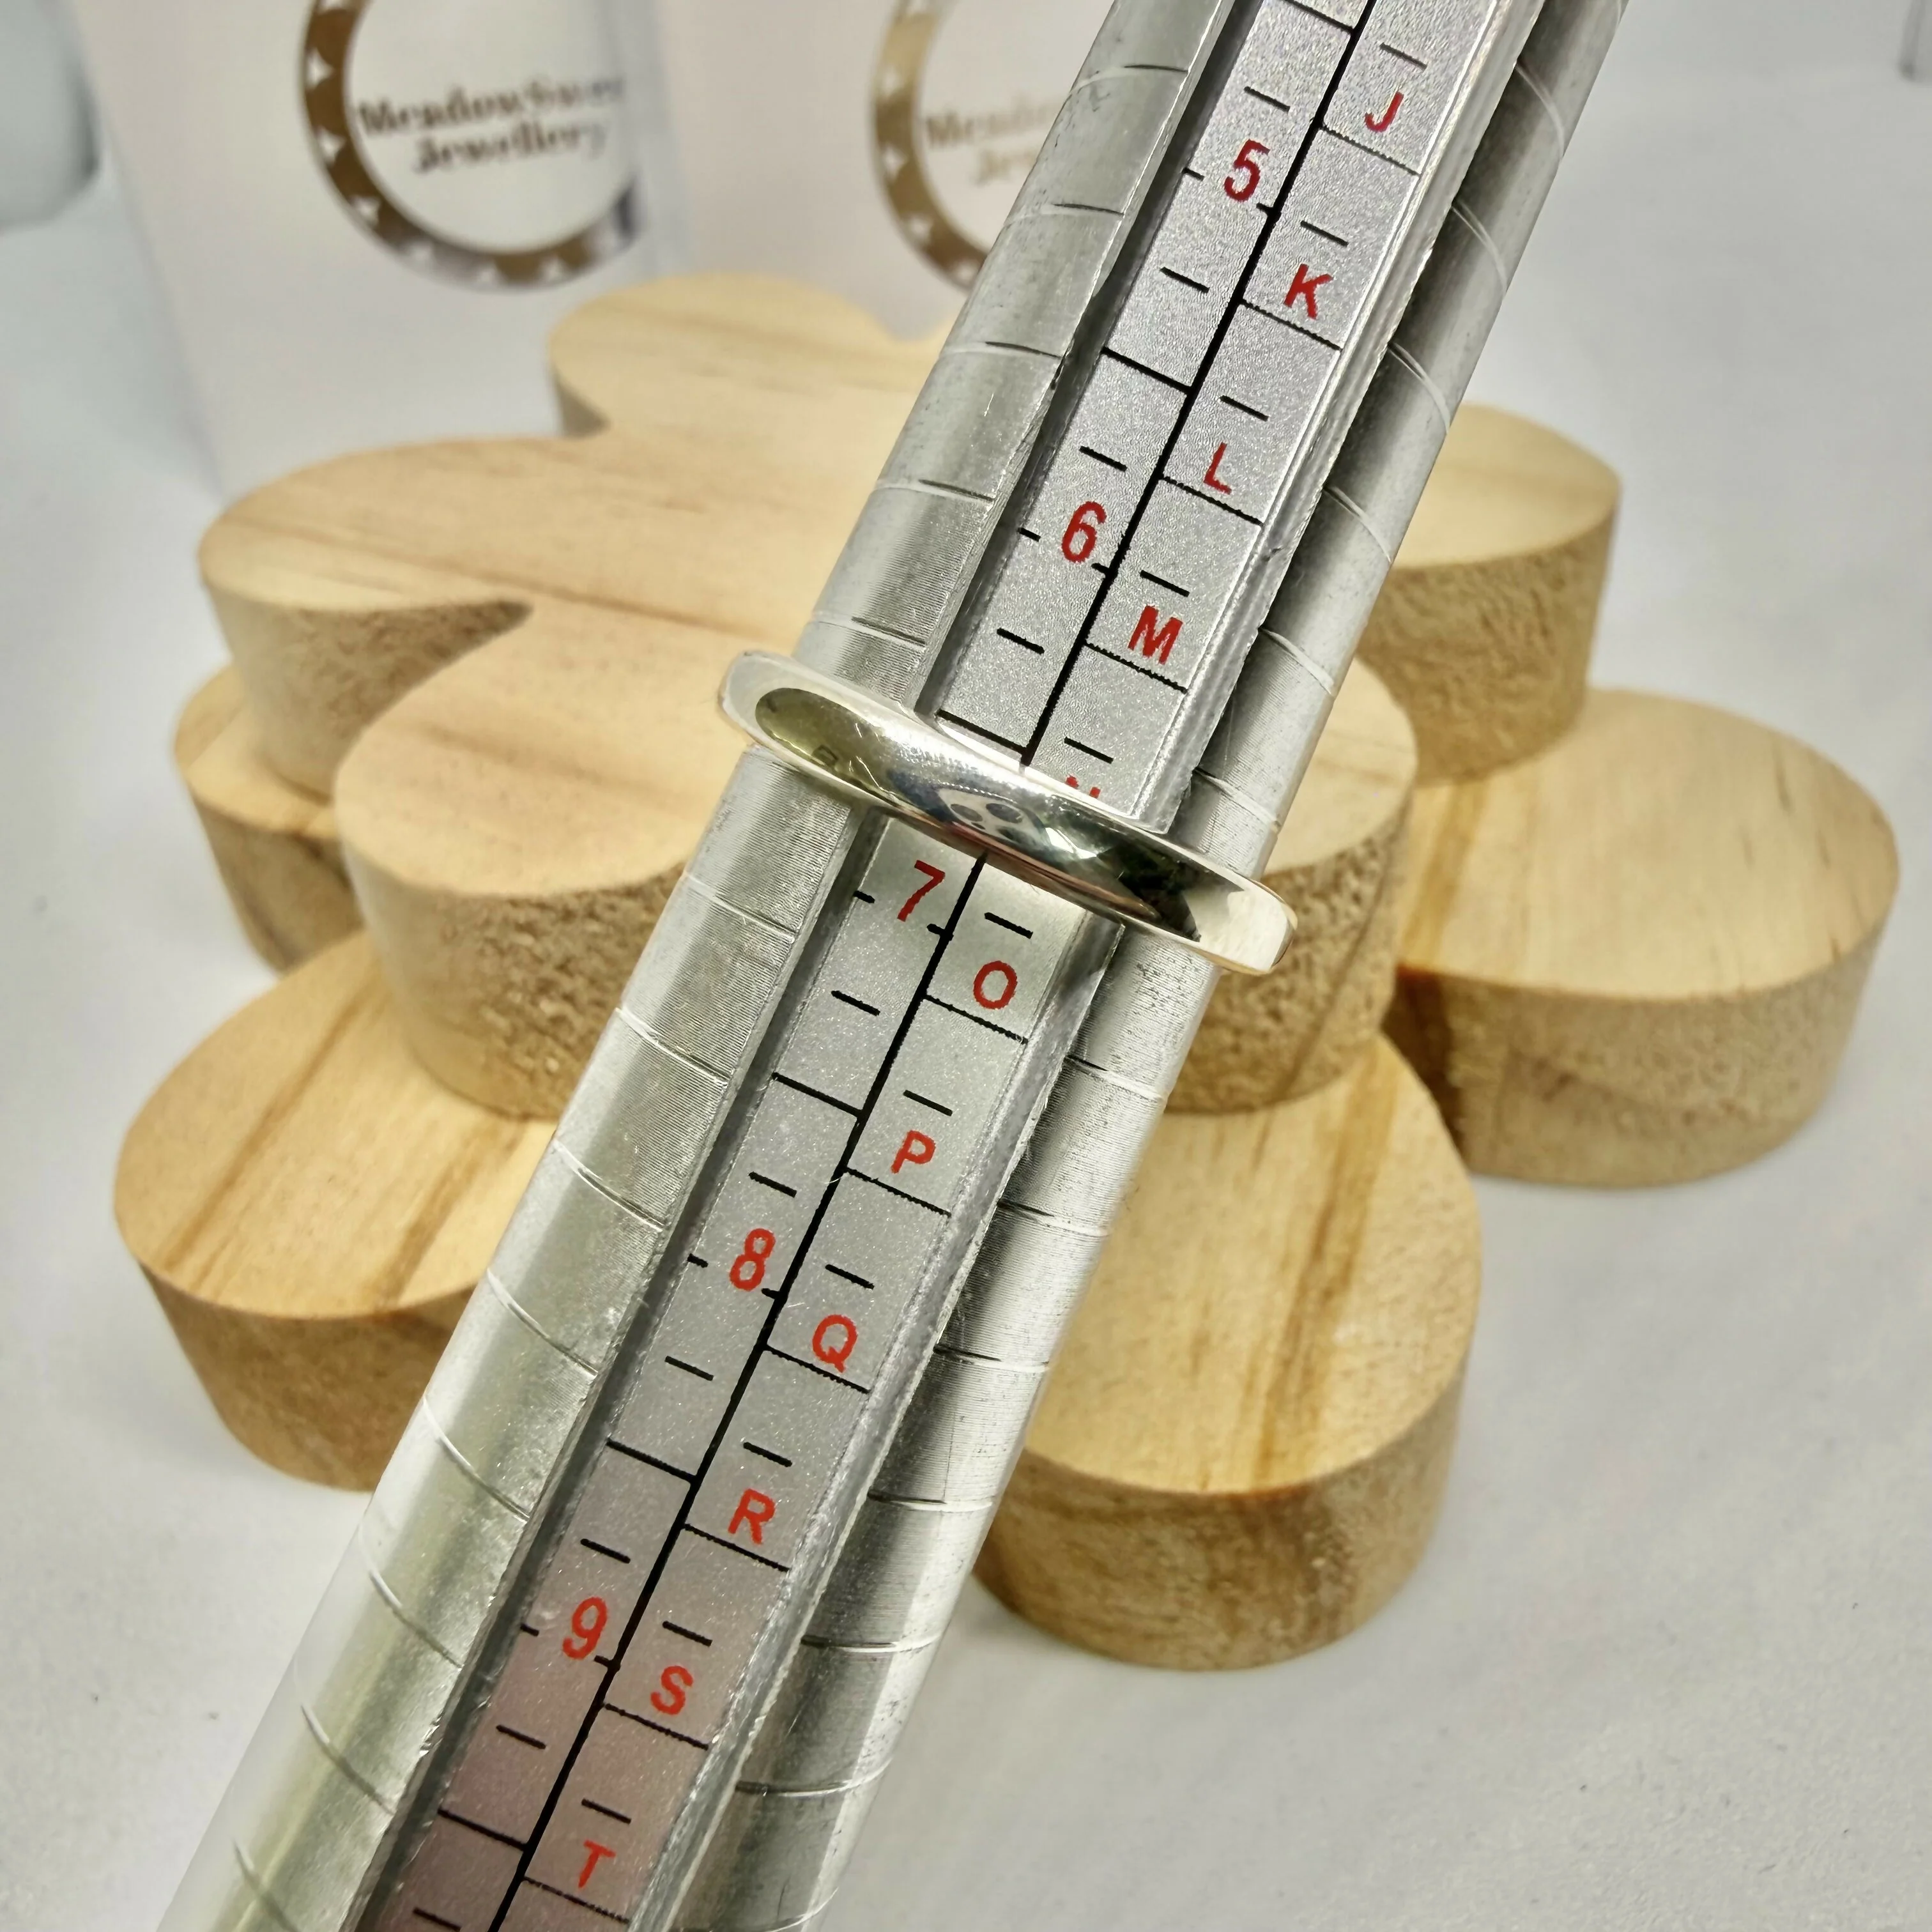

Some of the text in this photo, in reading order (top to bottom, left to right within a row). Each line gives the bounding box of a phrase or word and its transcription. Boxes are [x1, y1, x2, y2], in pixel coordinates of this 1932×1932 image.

[1365, 93, 1404, 132] J
[1224, 140, 1269, 201] 5
[1284, 265, 1331, 319] K
[1203, 443, 1230, 494] L
[1062, 502, 1106, 563] 6
[1128, 606, 1183, 664] M
[897, 861, 945, 921] 7
[973, 961, 1017, 1009] O
[891, 1130, 935, 1173] P
[730, 1228, 776, 1291] 8
[812, 1314, 857, 1373] Q
[728, 1488, 776, 1545] R
[562, 1596, 608, 1660] 9
[650, 1665, 694, 1717] S
[578, 1839, 617, 1889] T
